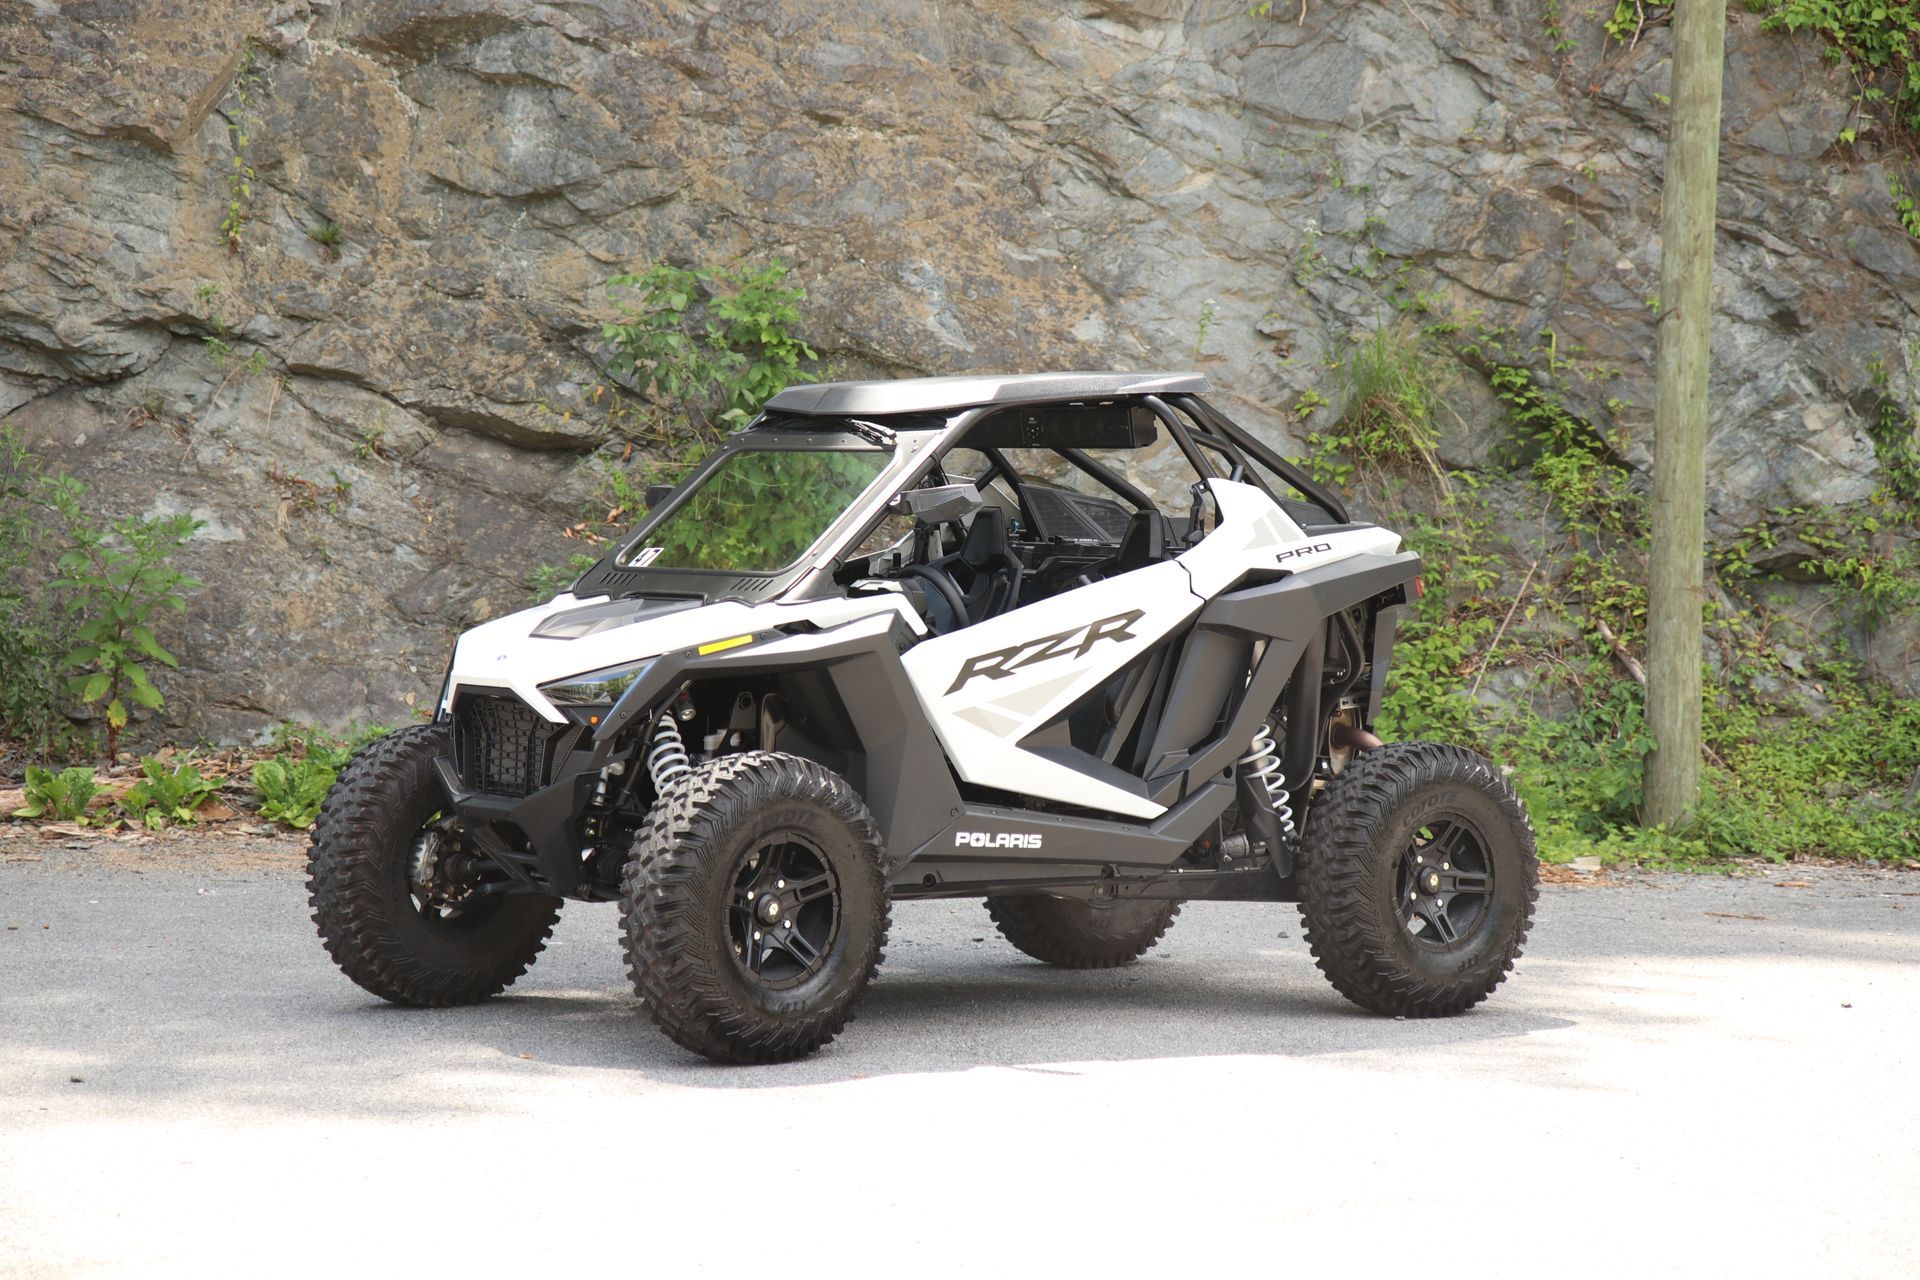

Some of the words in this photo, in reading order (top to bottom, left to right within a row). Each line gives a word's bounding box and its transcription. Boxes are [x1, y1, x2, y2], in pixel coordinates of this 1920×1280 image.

[1276, 543, 1332, 563] PRO
[942, 608, 1146, 697] RZR
[955, 832, 1042, 849] POLARIS
